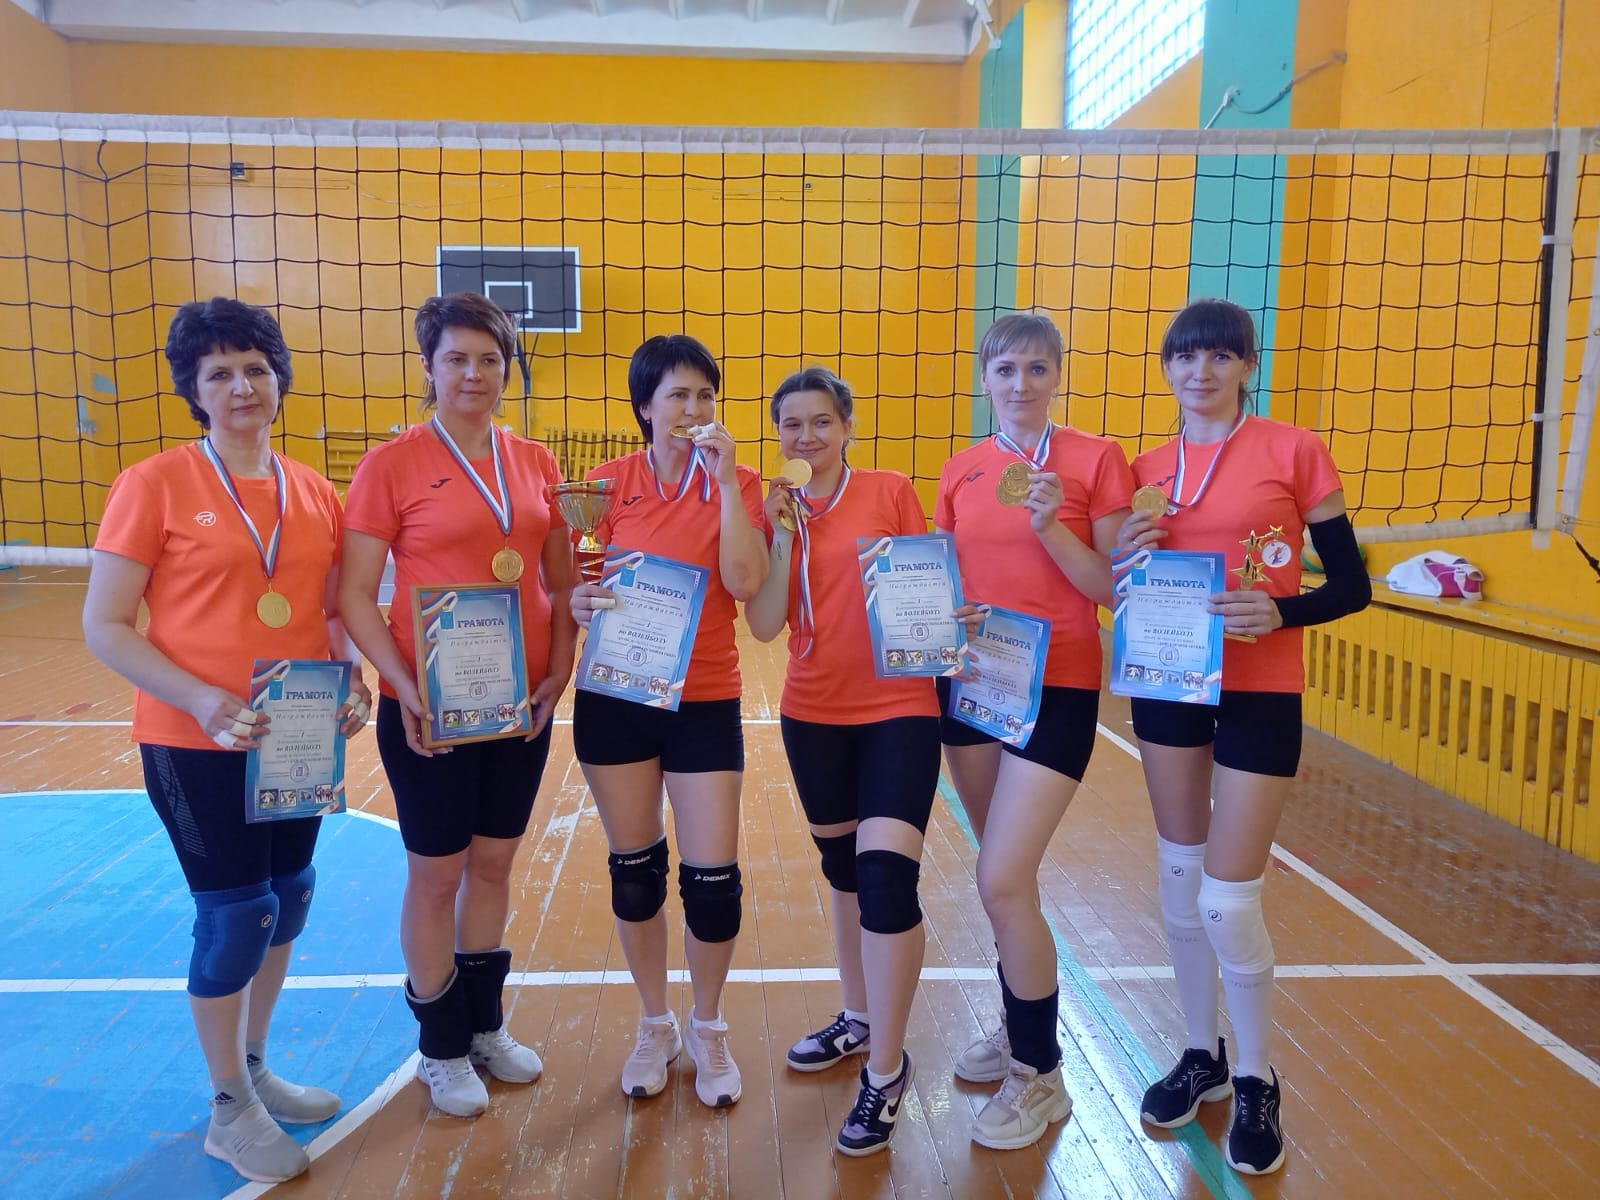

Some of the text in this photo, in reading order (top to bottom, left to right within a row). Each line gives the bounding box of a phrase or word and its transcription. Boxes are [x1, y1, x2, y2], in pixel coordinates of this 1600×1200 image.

[895, 562, 943, 572] ГРАМОТА
[1150, 578, 1206, 589] ГРАМОТА
[636, 581, 687, 600] ГРАМОТА
[457, 618, 505, 629] ГРАМОТА
[986, 631, 1032, 651] ГРАМОТА
[285, 691, 334, 700] ГРАМОТА
[623, 854, 652, 865] DEMIX
[702, 873, 731, 882] DEMIX
